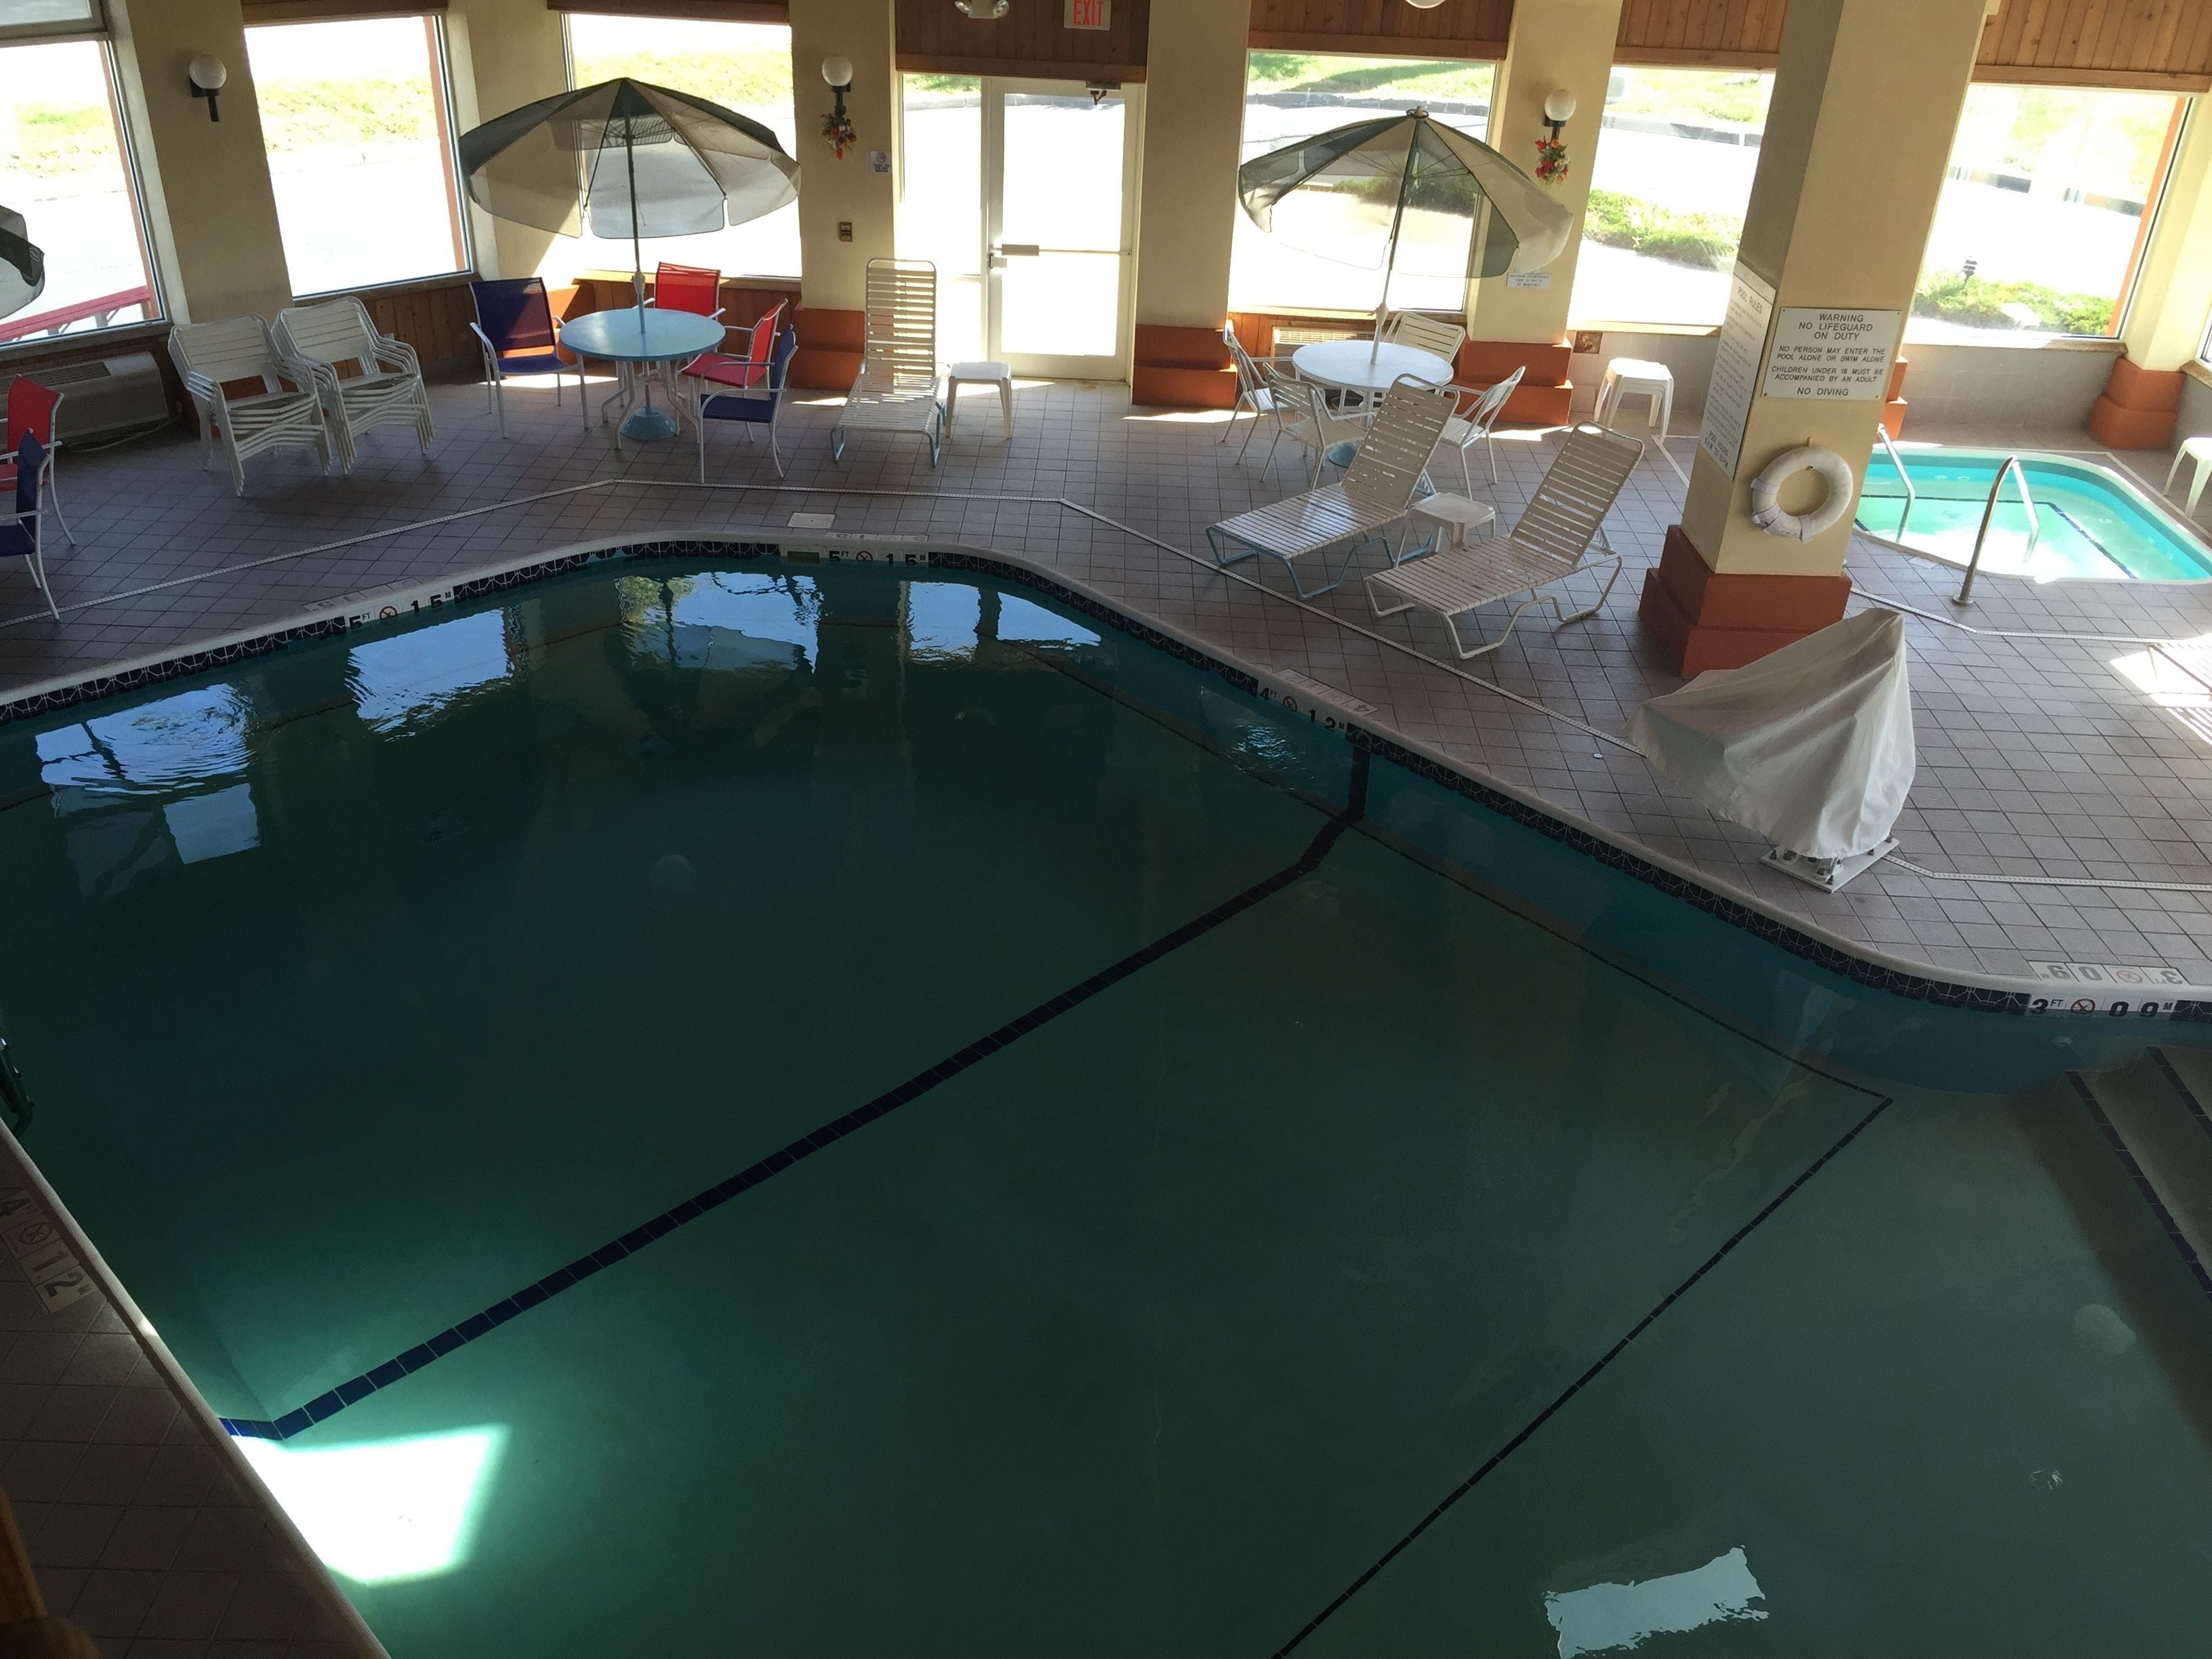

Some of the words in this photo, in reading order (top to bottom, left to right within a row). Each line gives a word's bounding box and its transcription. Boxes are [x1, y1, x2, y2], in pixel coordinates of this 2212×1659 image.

[1073, 0, 1104, 26] EXIT
[1819, 313, 1864, 322] WARNING
[1819, 323, 1872, 331] LIFEGUARD
[1814, 331, 1828, 340] ON
[1835, 332, 1860, 340] DUTY
[1771, 365, 1807, 373] CHILDREN
[1774, 373, 1825, 382] ACCOMPANIED
[1797, 387, 1811, 395] NO
[1816, 388, 1849, 396] DIVING
